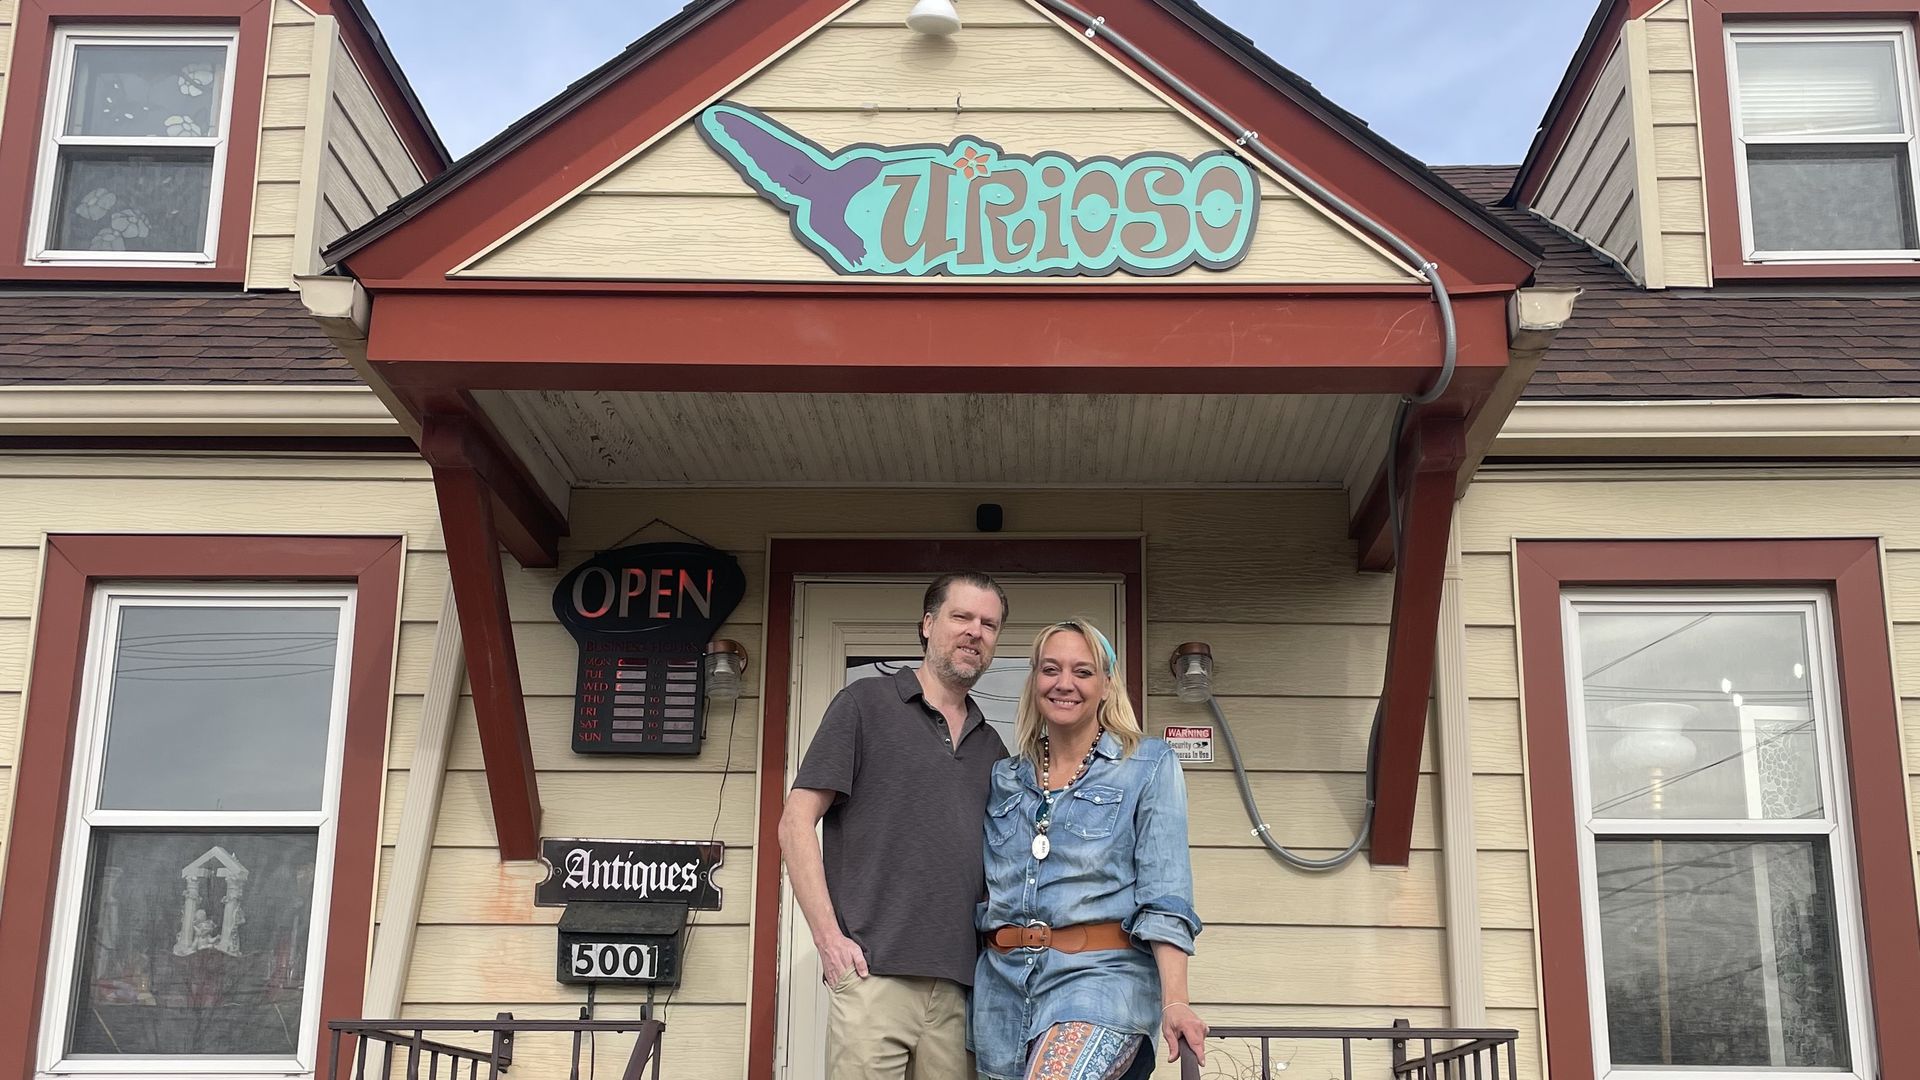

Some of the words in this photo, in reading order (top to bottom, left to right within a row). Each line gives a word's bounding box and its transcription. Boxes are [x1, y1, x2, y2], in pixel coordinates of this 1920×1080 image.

[572, 566, 714, 619] OPEN
[584, 657, 611, 667] MON
[585, 669, 604, 678] TUE
[583, 682, 609, 691] WED
[582, 695, 605, 704] THU
[649, 696, 660, 704] TO
[580, 707, 597, 717] FRI
[649, 709, 659, 717] TO
[580, 720, 599, 729] SAT
[648, 721, 658, 729] TO
[579, 732, 602, 742] SUN
[647, 734, 658, 742] TO
[1168, 728, 1210, 738] WARNING
[1192, 751, 1198, 759] In
[1199, 751, 1209, 759] Use
[562, 848, 700, 899] Antiques
[574, 944, 657, 978] 5001
